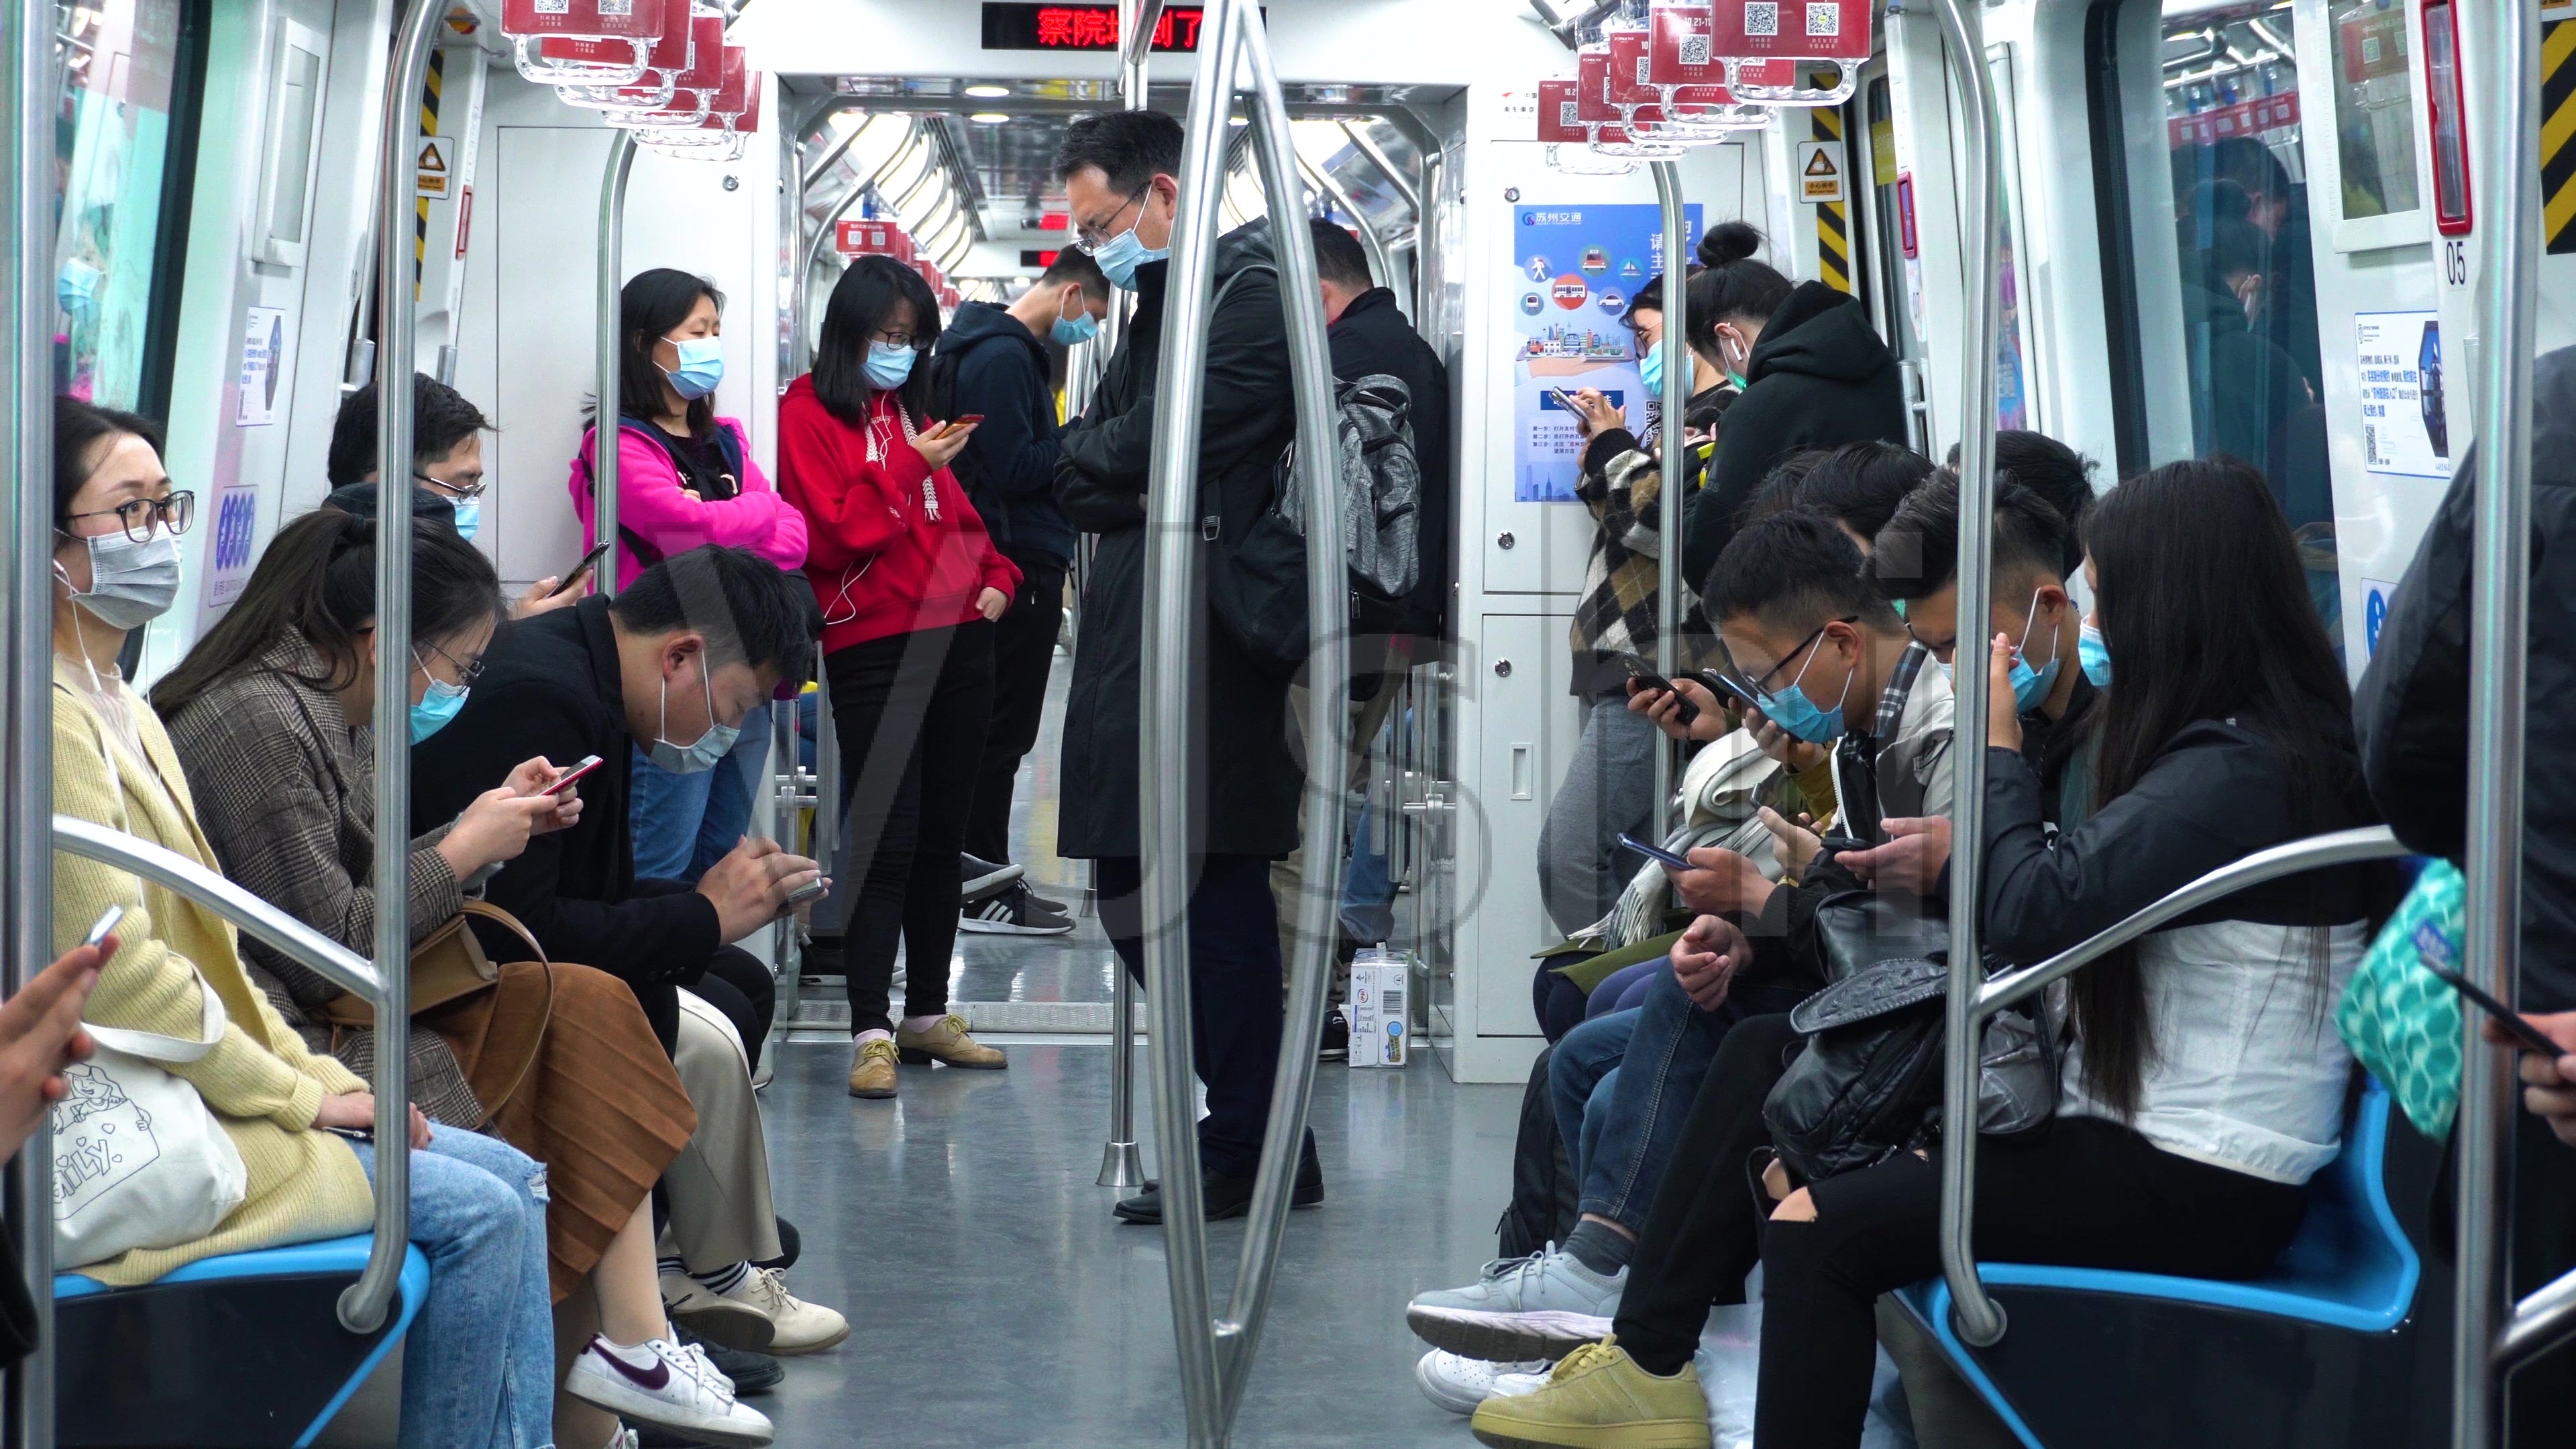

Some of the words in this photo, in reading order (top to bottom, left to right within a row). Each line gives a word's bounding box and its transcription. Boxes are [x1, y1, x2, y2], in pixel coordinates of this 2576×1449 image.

[1536, 212, 1582, 222] 苏州交通
[2447, 241, 2465, 286] 05
